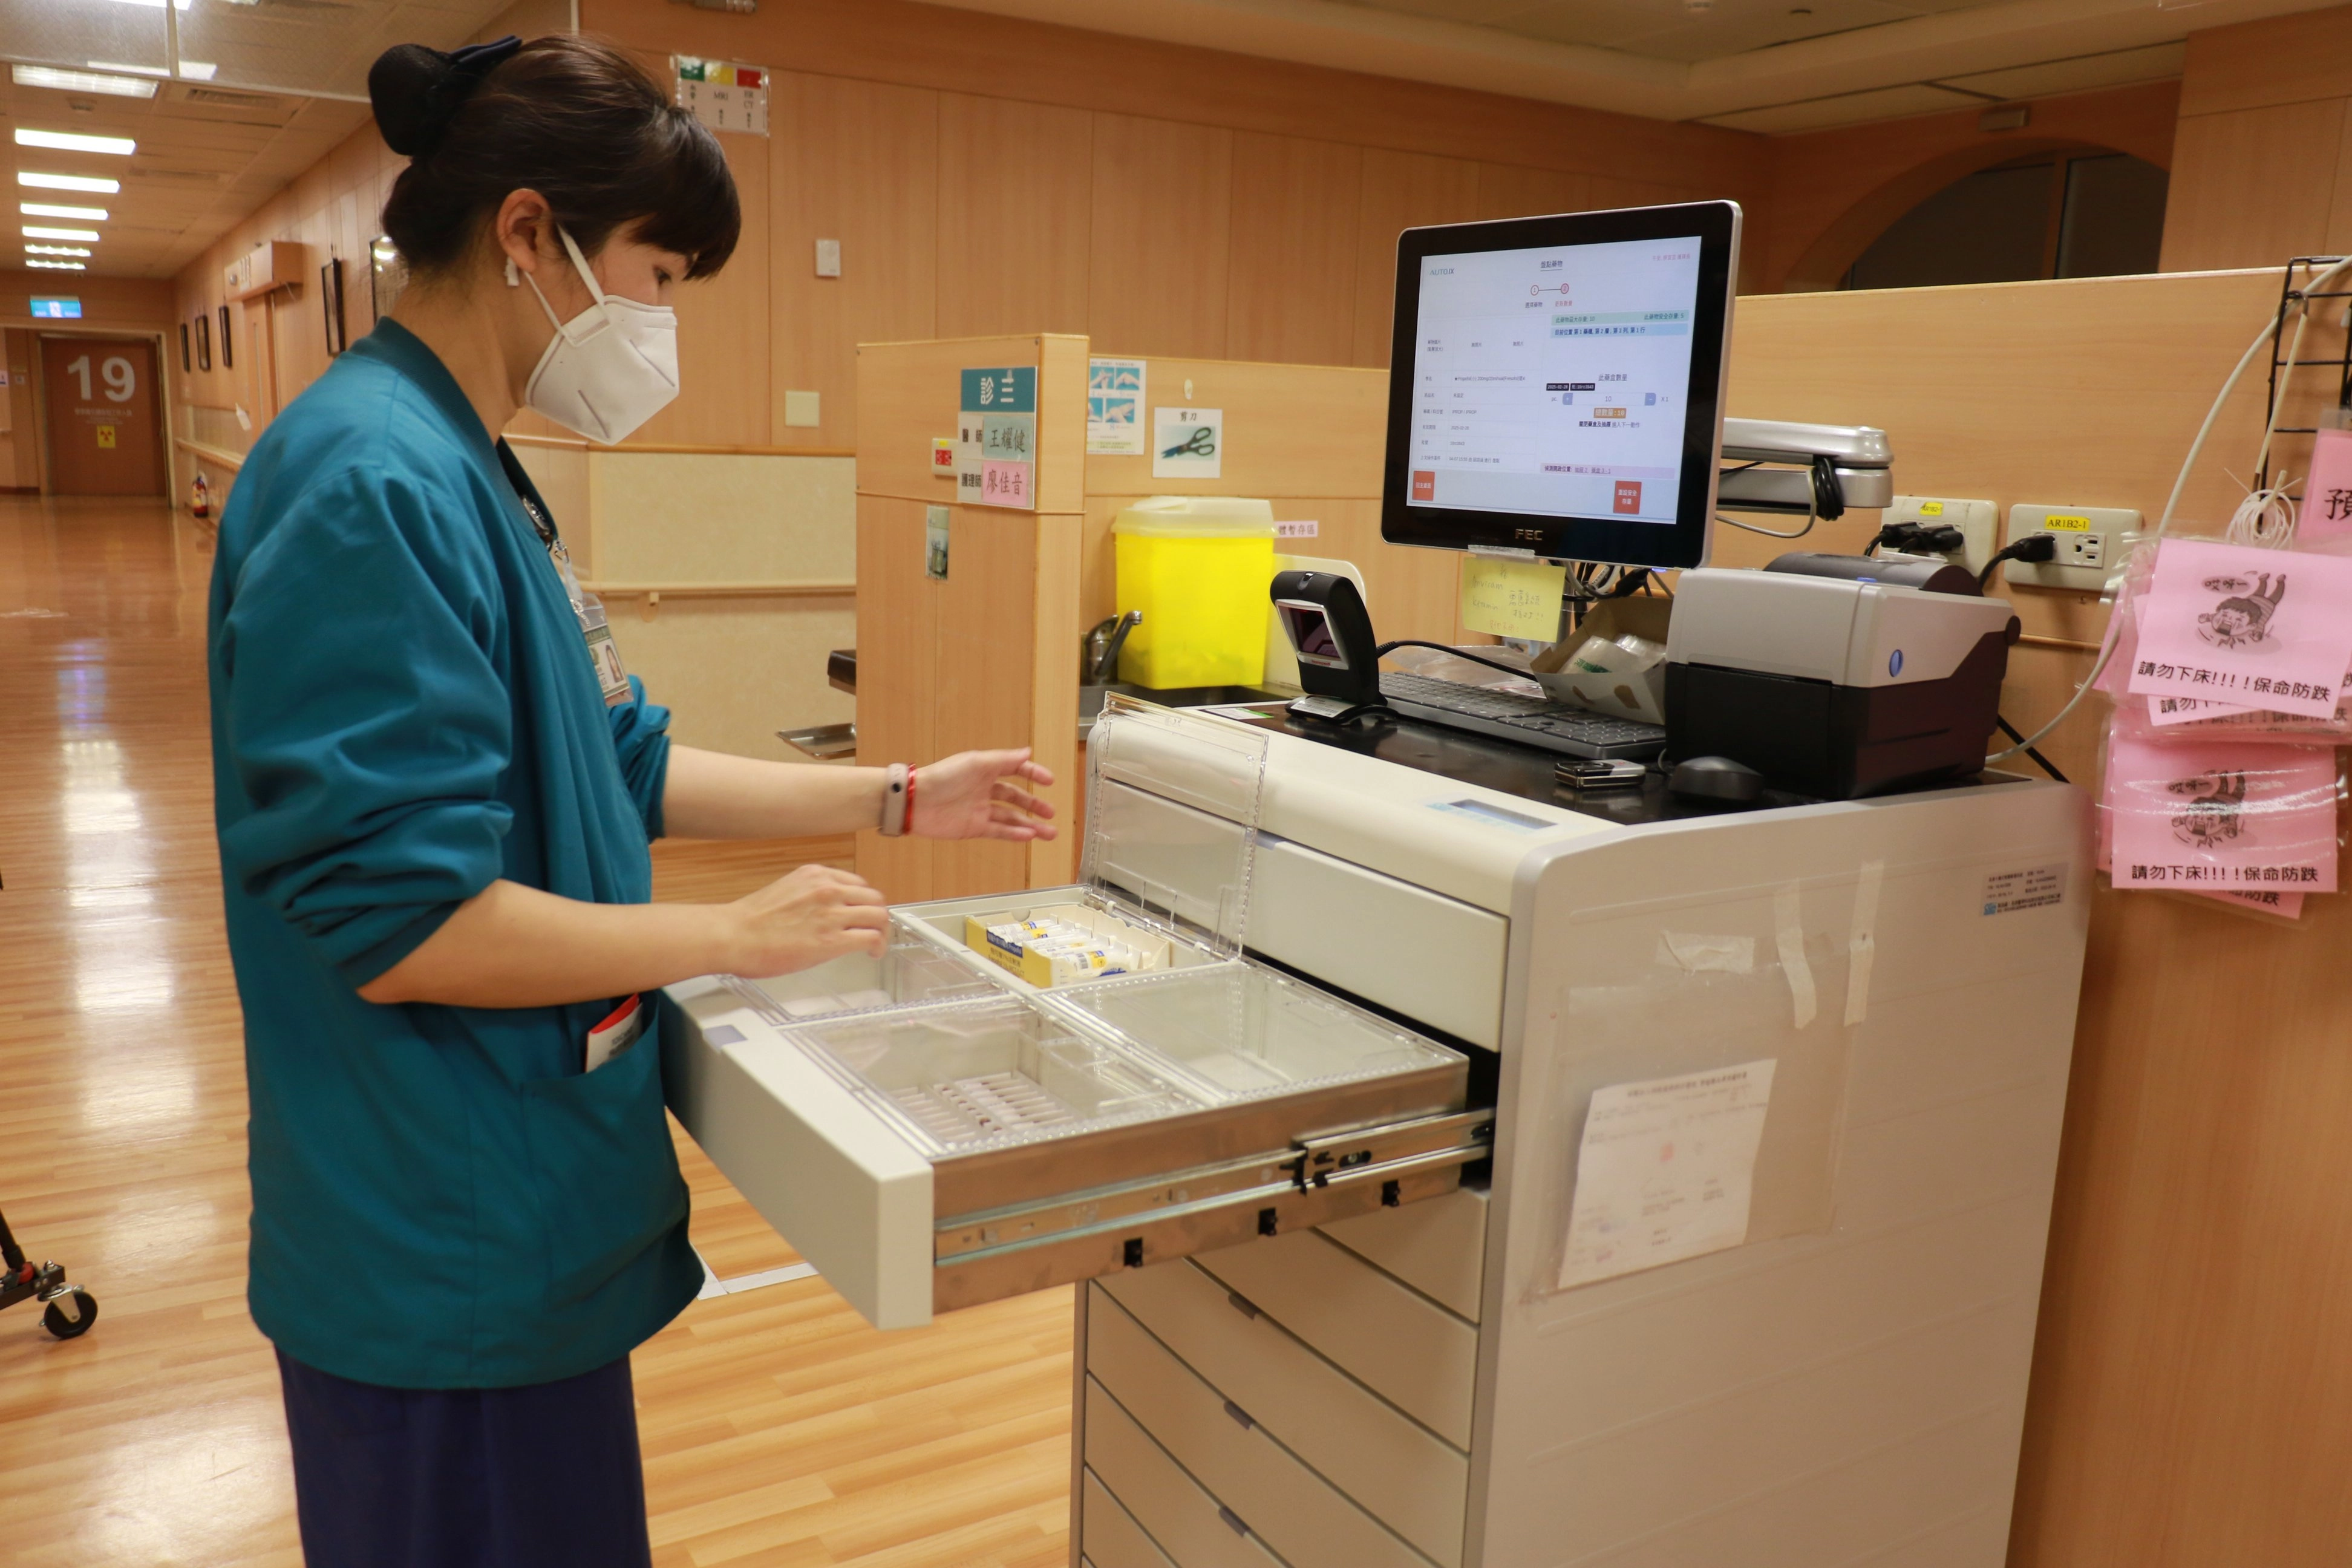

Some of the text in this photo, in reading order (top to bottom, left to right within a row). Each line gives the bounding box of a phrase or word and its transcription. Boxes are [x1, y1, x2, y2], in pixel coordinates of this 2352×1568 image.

[67, 354, 136, 403] 19
[980, 376, 1014, 405] 診三
[1180, 411, 1197, 422] 剪刀
[989, 426, 1025, 452] 王耀健
[987, 469, 1022, 495] 廖佳音
[1515, 528, 1544, 541] FEC
[2047, 518, 2088, 530] AR1B2-1
